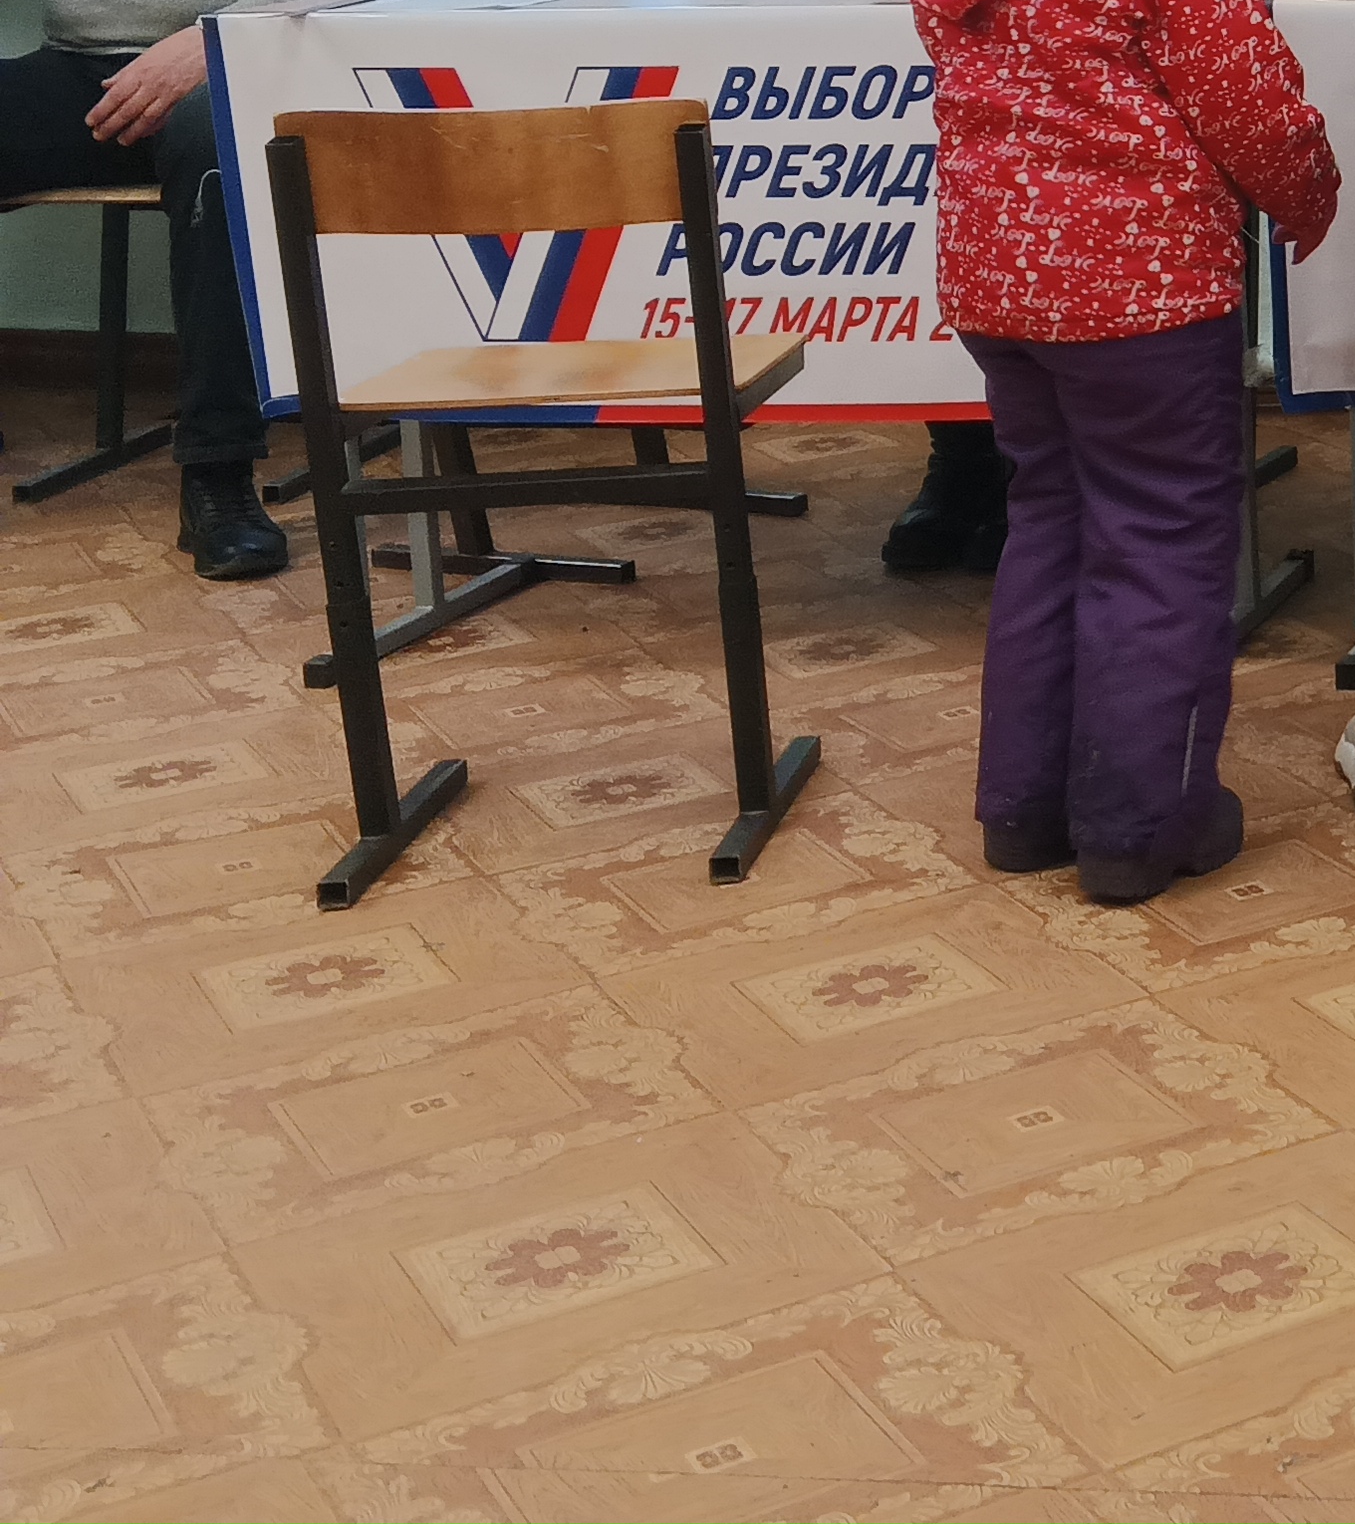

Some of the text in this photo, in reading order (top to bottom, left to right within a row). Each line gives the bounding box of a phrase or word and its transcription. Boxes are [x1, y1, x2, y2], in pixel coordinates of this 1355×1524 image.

[710, 65, 935, 121] ВЫБОР
[712, 143, 937, 206] РЕЗИД
[769, 297, 919, 342] МАРТА
